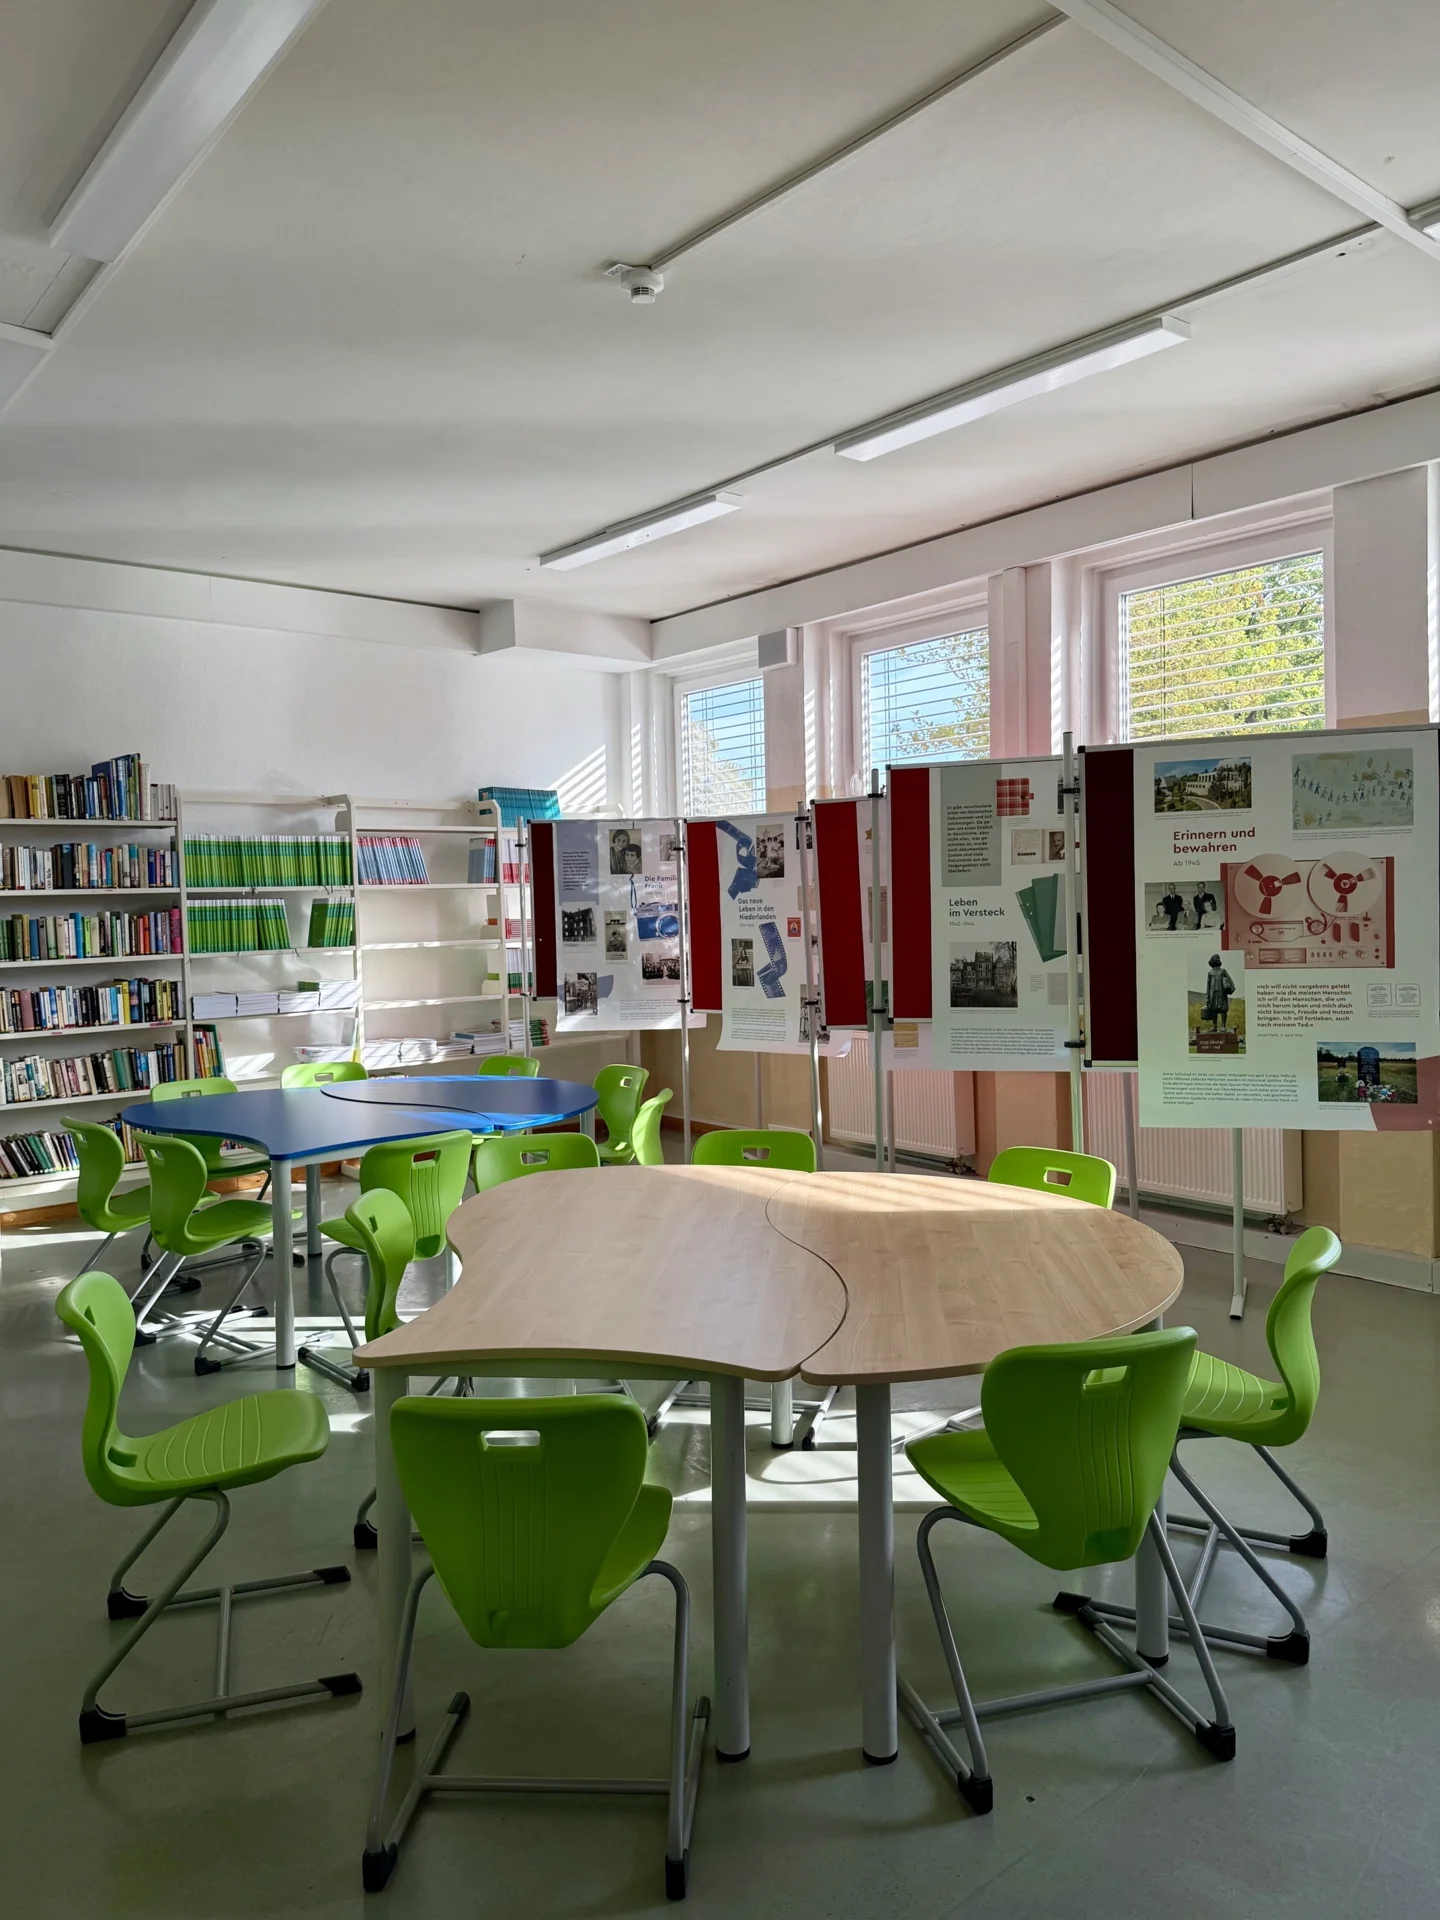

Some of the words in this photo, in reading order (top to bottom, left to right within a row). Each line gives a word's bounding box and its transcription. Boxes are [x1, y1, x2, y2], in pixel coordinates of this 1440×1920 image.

[1173, 830, 1226, 840] Erinnern
[1231, 826, 1255, 838] und
[1173, 842, 1237, 854] bewahren
[949, 898, 978, 906] Leben
[963, 908, 1005, 916] Versteck
